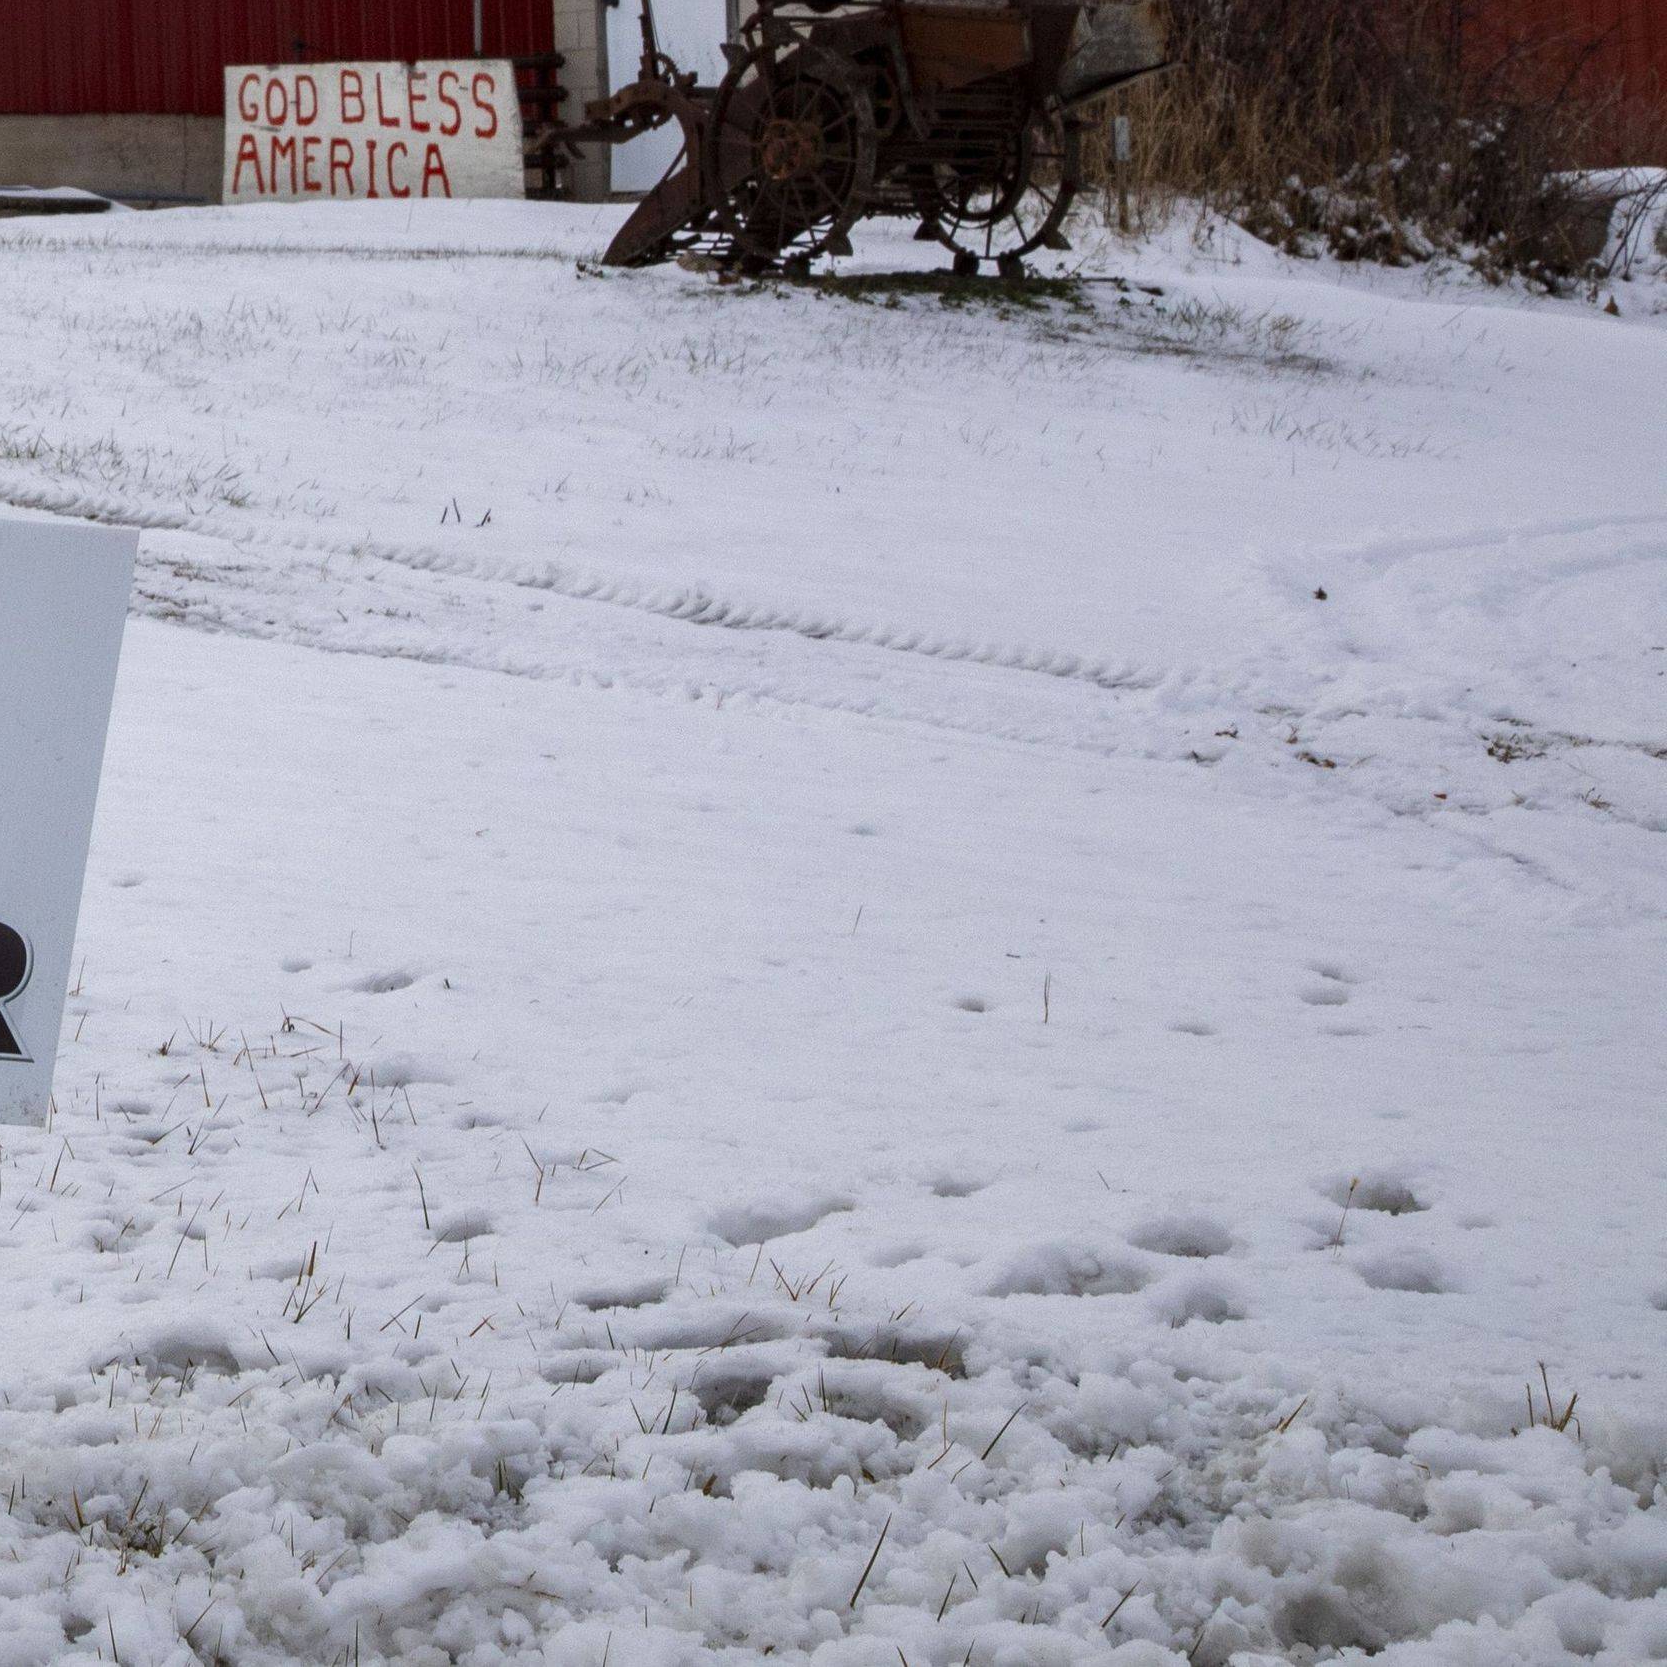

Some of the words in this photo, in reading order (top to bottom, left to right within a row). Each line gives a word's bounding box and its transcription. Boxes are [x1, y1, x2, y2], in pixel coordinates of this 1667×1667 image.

[238, 73, 318, 126] GOD
[340, 70, 498, 138] BLESS
[232, 134, 452, 198] AMERICA
